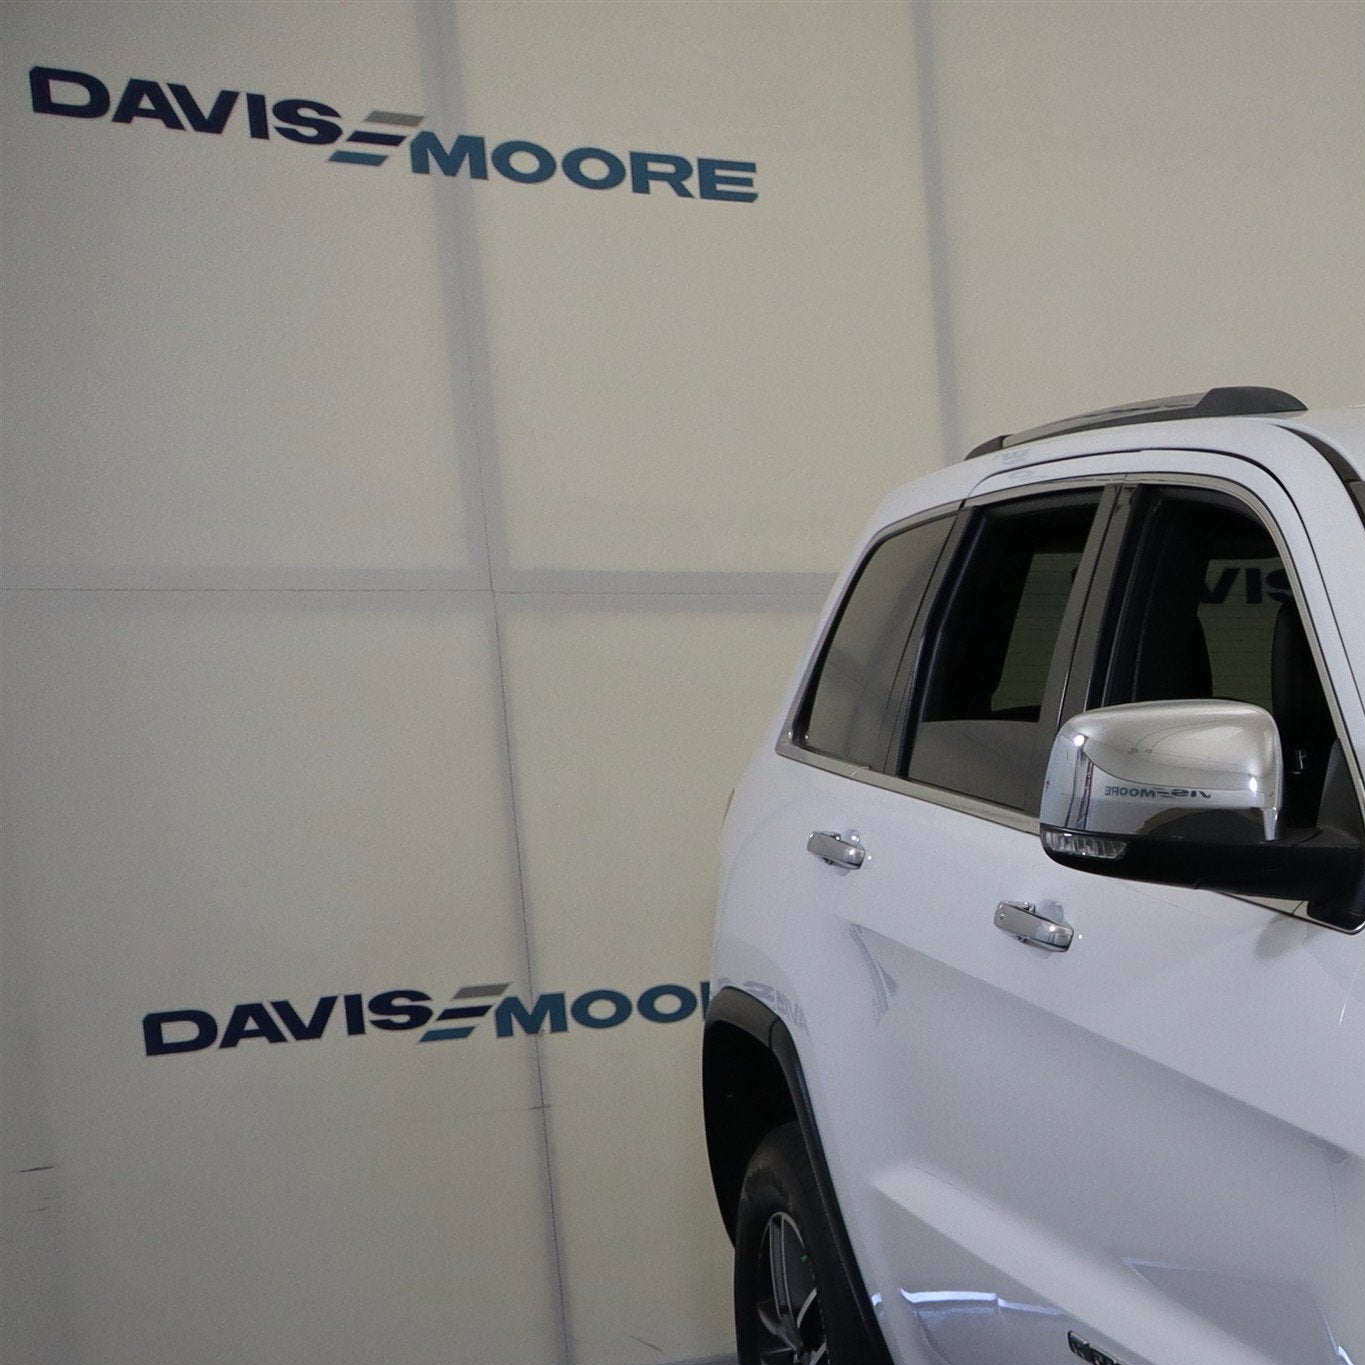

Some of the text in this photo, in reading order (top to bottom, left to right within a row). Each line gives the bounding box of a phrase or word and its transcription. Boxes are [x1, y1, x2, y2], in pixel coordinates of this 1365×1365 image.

[28, 64, 759, 204] DAVIS MOORE
[142, 989, 434, 1057] DAVIS
[494, 981, 711, 1039] MOO
